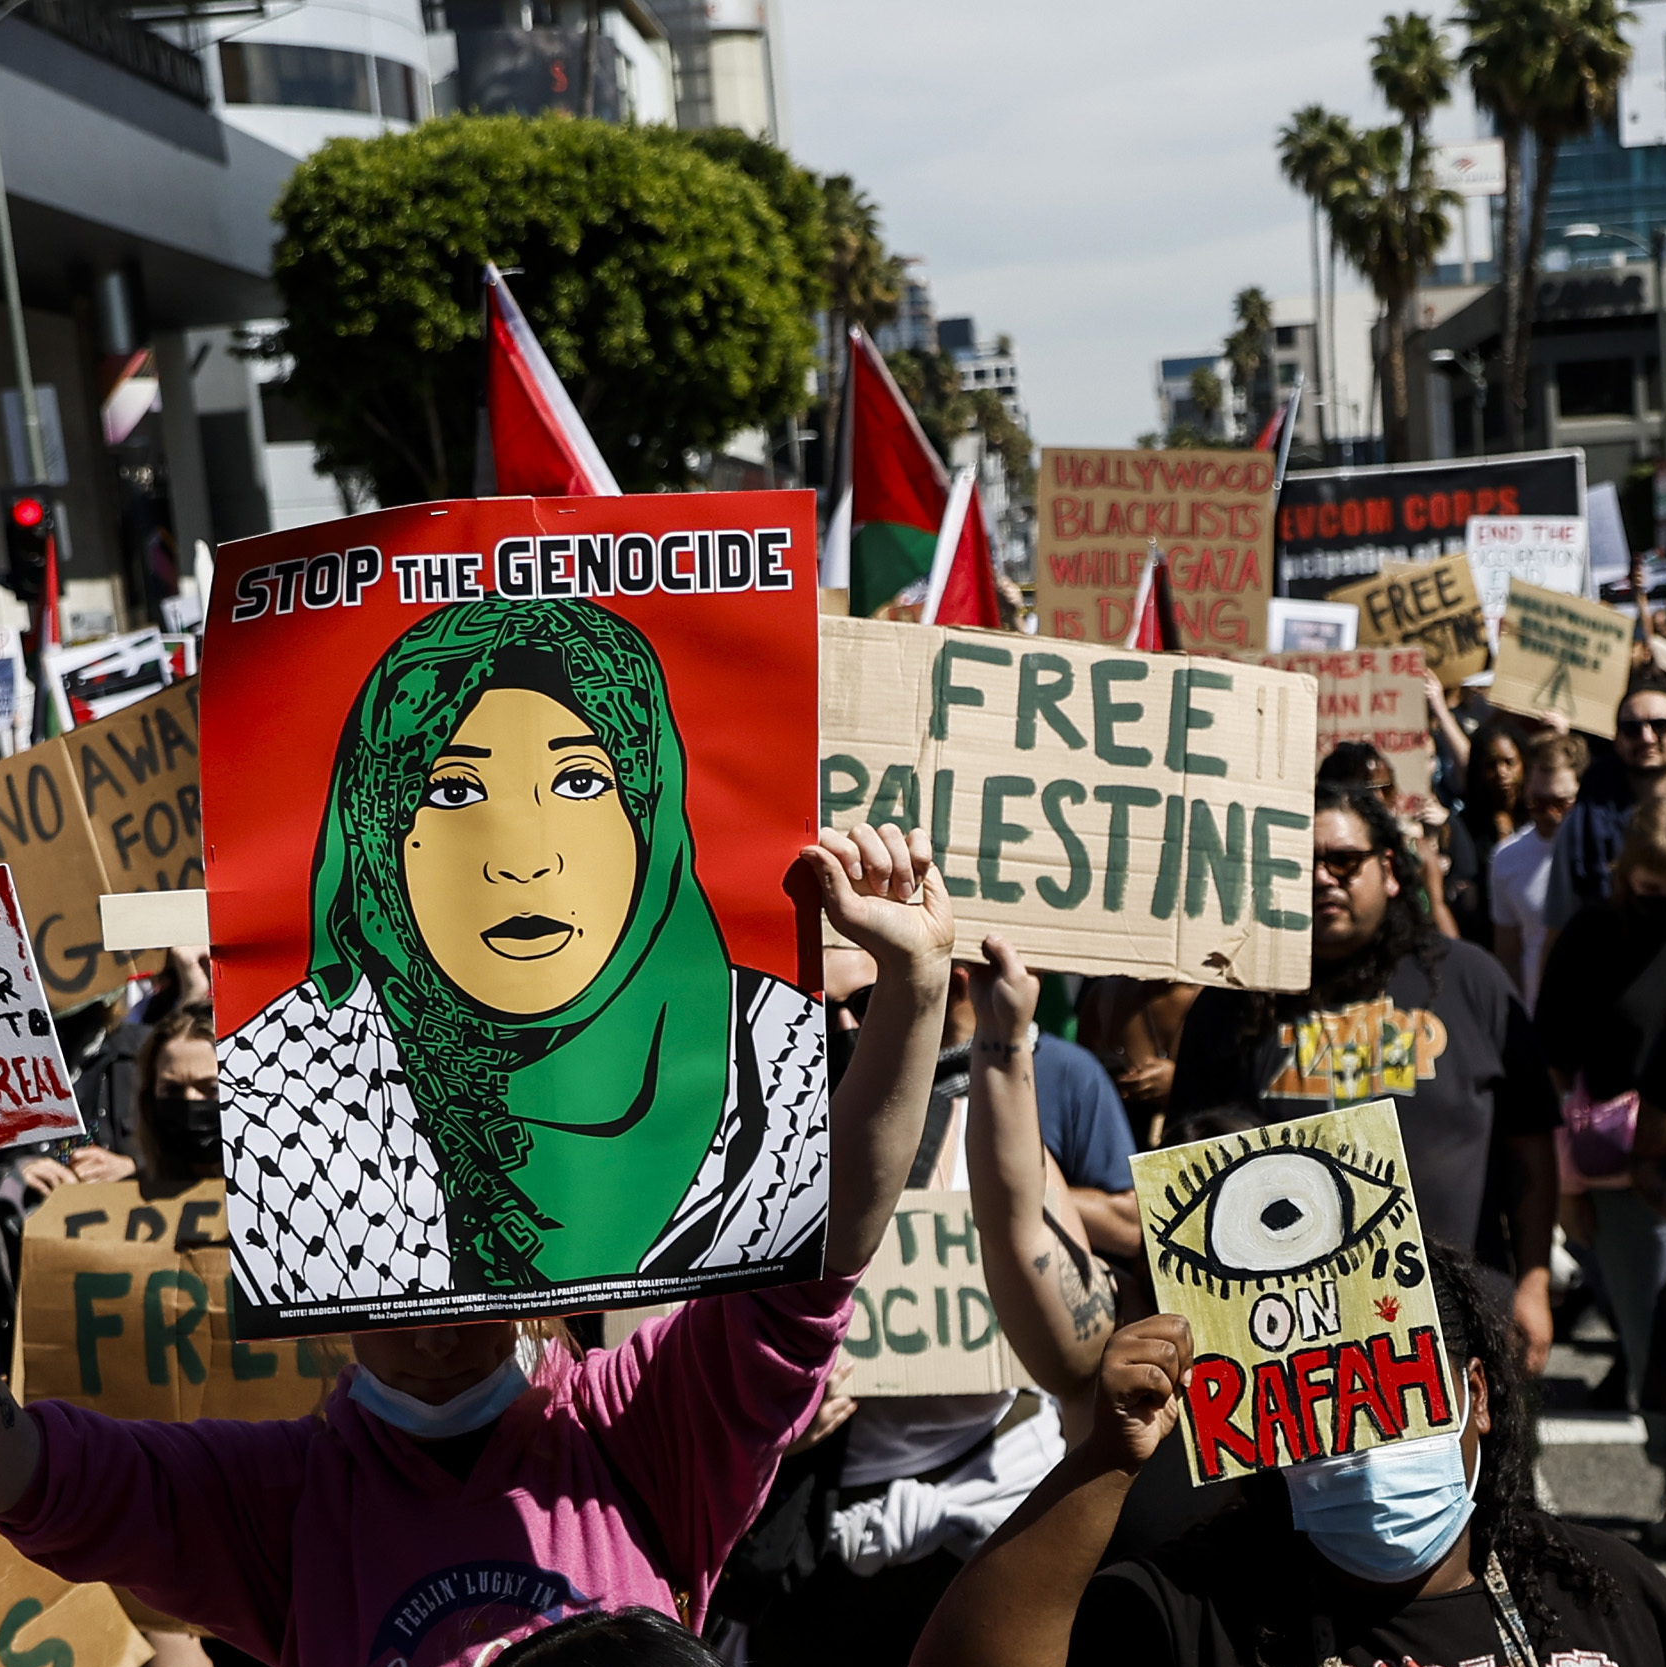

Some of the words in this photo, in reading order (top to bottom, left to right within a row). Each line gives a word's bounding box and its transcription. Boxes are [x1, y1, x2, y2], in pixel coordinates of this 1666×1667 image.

[1056, 455, 1274, 494] HOLLYWOOD
[1052, 497, 1262, 541] BLACKLISTS
[231, 545, 381, 621] STOP
[391, 552, 484, 603] THE
[494, 527, 792, 601] GENOCIDE
[1048, 550, 1145, 588] WHILE
[1166, 546, 1263, 593] GAZA
[1365, 567, 1464, 635] FREE
[1053, 609, 1084, 639] IS
[1097, 596, 1248, 648] DNG
[930, 640, 1233, 777] FREE
[110, 784, 201, 870] FOR
[820, 753, 1311, 932] PALESTINE
[893, 1208, 979, 1268] TH
[280, 1308, 308, 1319] INCITE!
[308, 1306, 341, 1317] RADICAL
[341, 1303, 382, 1314] FEMINISTS
[382, 1301, 393, 1311] OF
[393, 1299, 419, 1310] COLOR
[419, 1296, 451, 1308] AGAINST
[451, 1293, 487, 1305] VIOLENCE
[487, 1287, 551, 1301] incite-national.org
[557, 1281, 602, 1296] PALESTINIAN
[602, 1279, 637, 1291] FEMINIST
[637, 1276, 680, 1289] COLLECTIVE
[680, 1264, 784, 1285] palestinianfeministcollective.org
[369, 1312, 385, 1320] Heba
[409, 1310, 422, 1318] was
[422, 1307, 440, 1316] killed
[440, 1305, 457, 1316] along
[457, 1304, 473, 1314] with
[473, 1303, 486, 1313] her
[486, 1301, 513, 1312] children
[513, 1301, 521, 1311] by
[530, 1299, 551, 1309] Israeli
[551, 1296, 579, 1306] airstrike
[579, 1295, 587, 1303] on
[587, 1292, 613, 1303] October
[641, 1287, 652, 1296] Art
[652, 1286, 660, 1297] by
[841, 1285, 1000, 1358] OCID
[1249, 1280, 1342, 1353] ON
[1184, 1325, 1452, 1486] RAFAH
[394, 1571, 458, 1637] FEELIN'
[465, 1571, 528, 1597] LUCKY
[530, 1581, 558, 1612] IN
